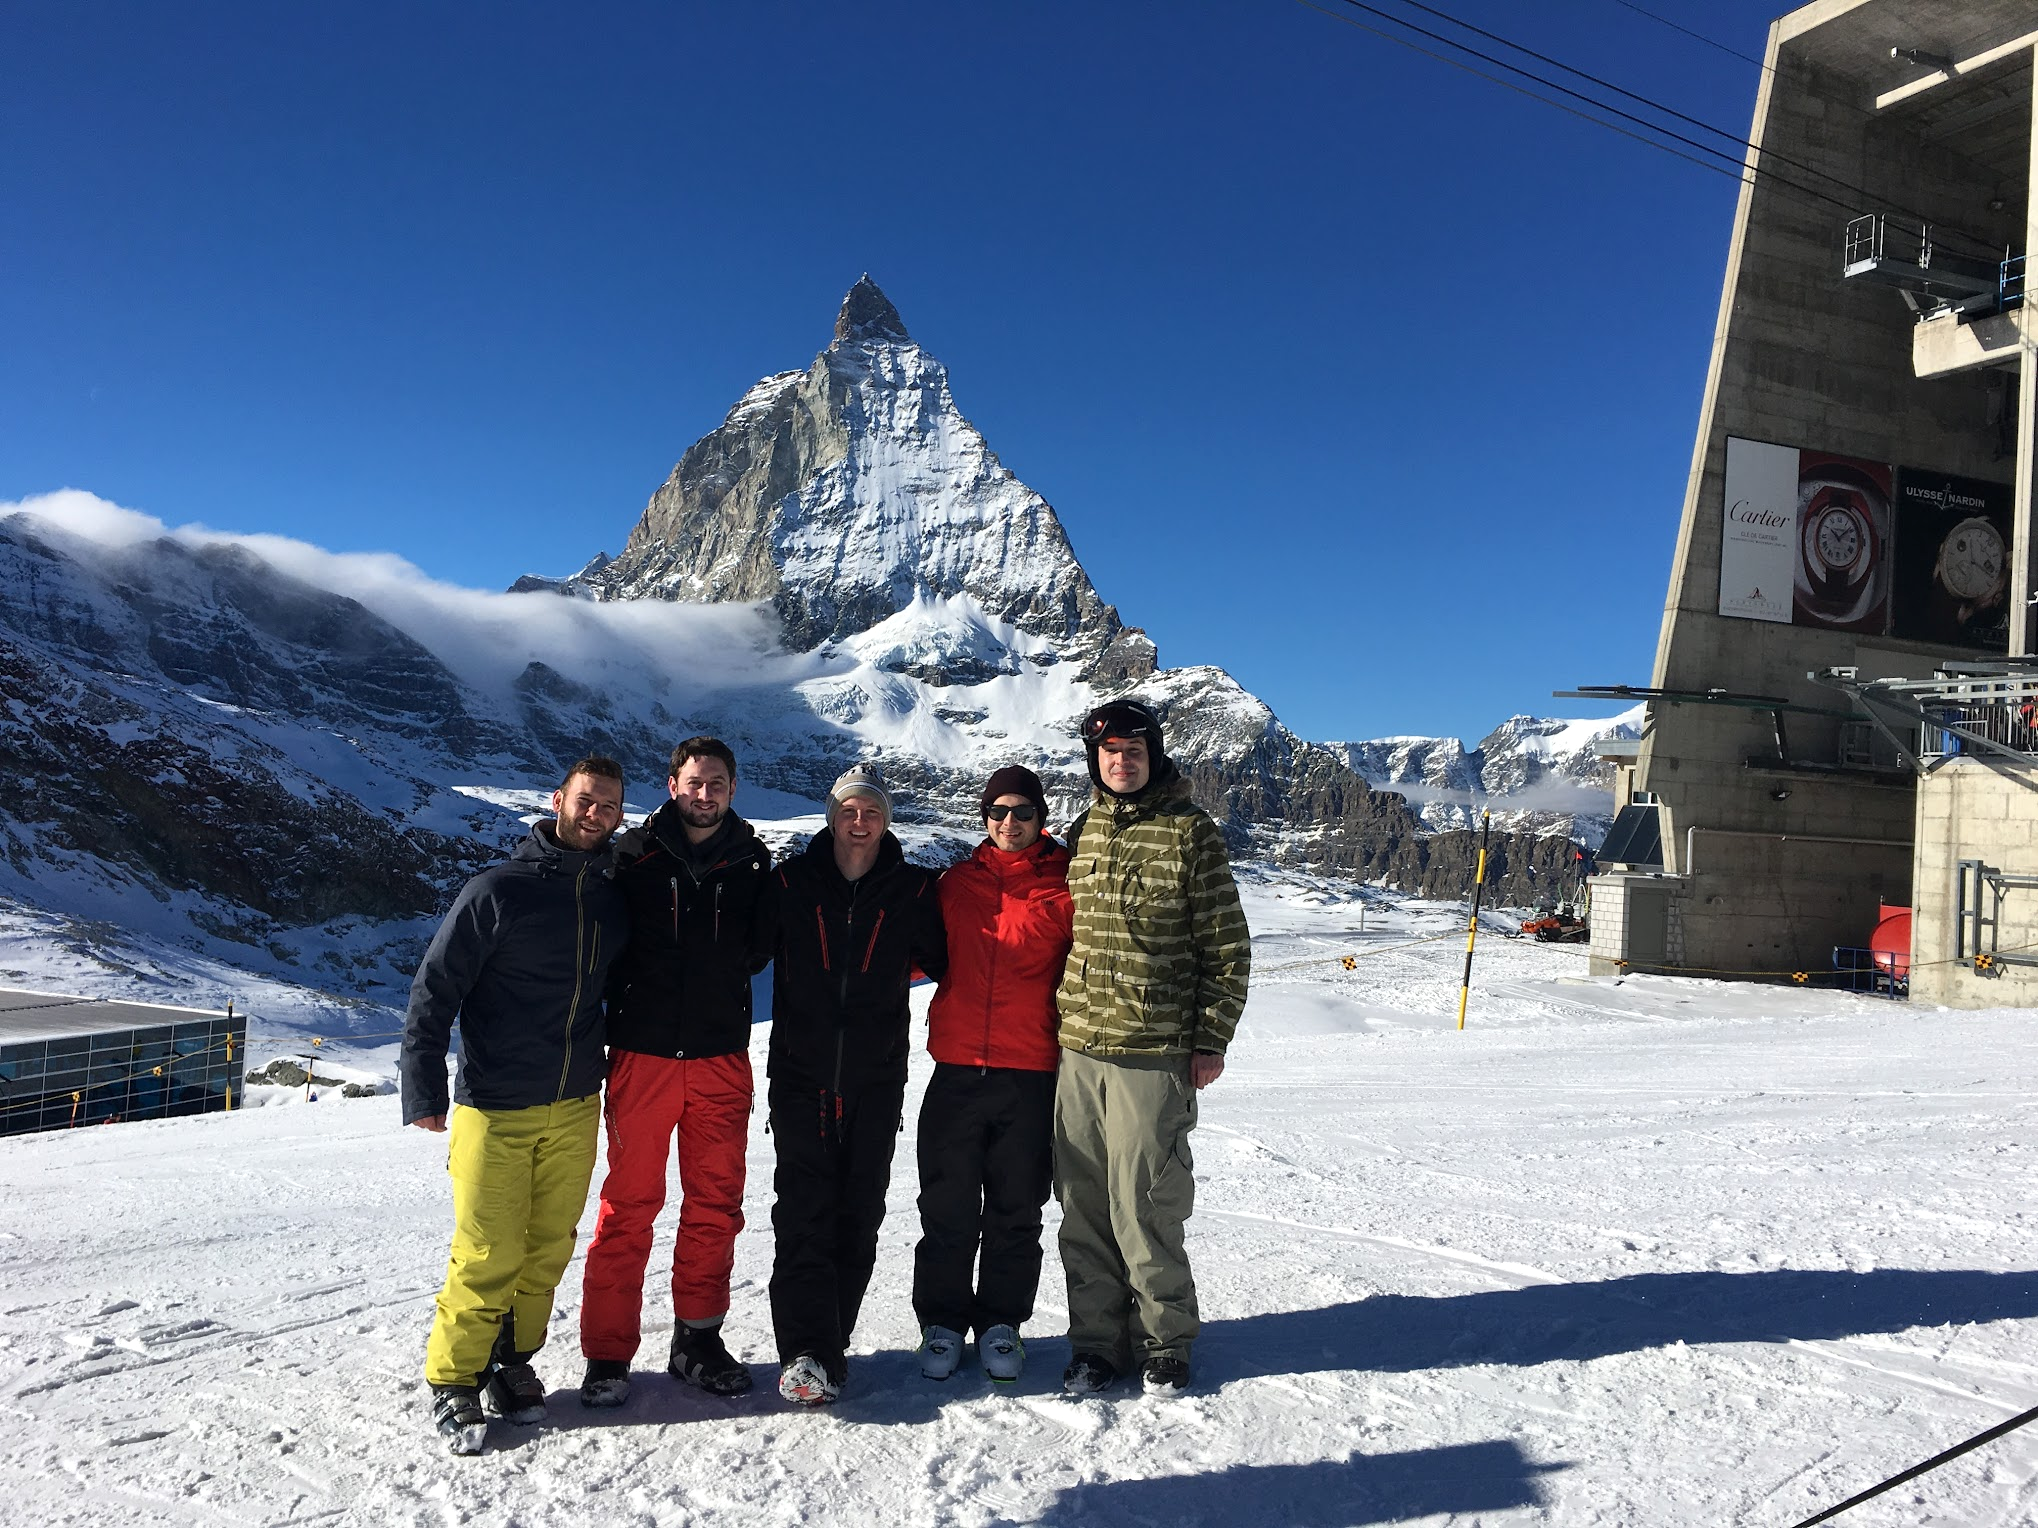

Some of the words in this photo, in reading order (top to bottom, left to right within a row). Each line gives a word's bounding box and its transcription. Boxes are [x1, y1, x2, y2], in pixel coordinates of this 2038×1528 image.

[1906, 486, 1943, 501] ULYSSE
[1948, 494, 1985, 508] NARDIN
[1730, 499, 1790, 528] Cartier
